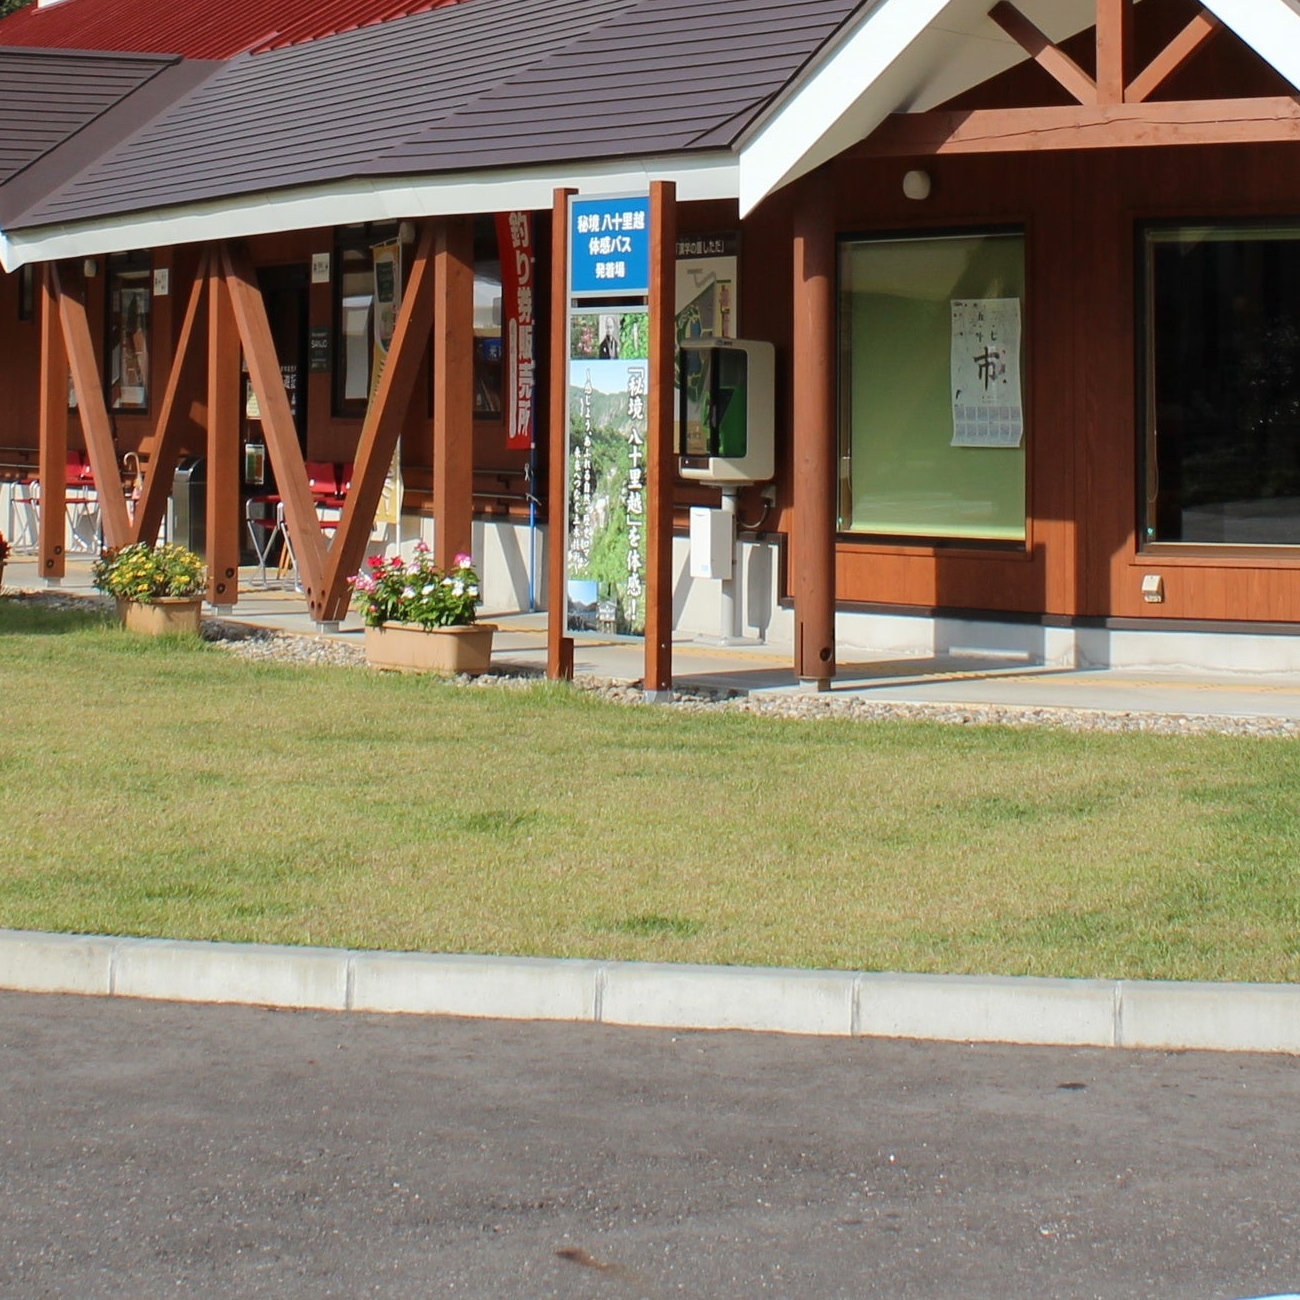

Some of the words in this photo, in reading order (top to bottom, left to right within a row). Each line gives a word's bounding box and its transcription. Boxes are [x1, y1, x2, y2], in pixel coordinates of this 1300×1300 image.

[589, 236, 632, 256] 体感バス
[595, 261, 626, 278] 発着場
[508, 212, 536, 437] 釣り券販売所
